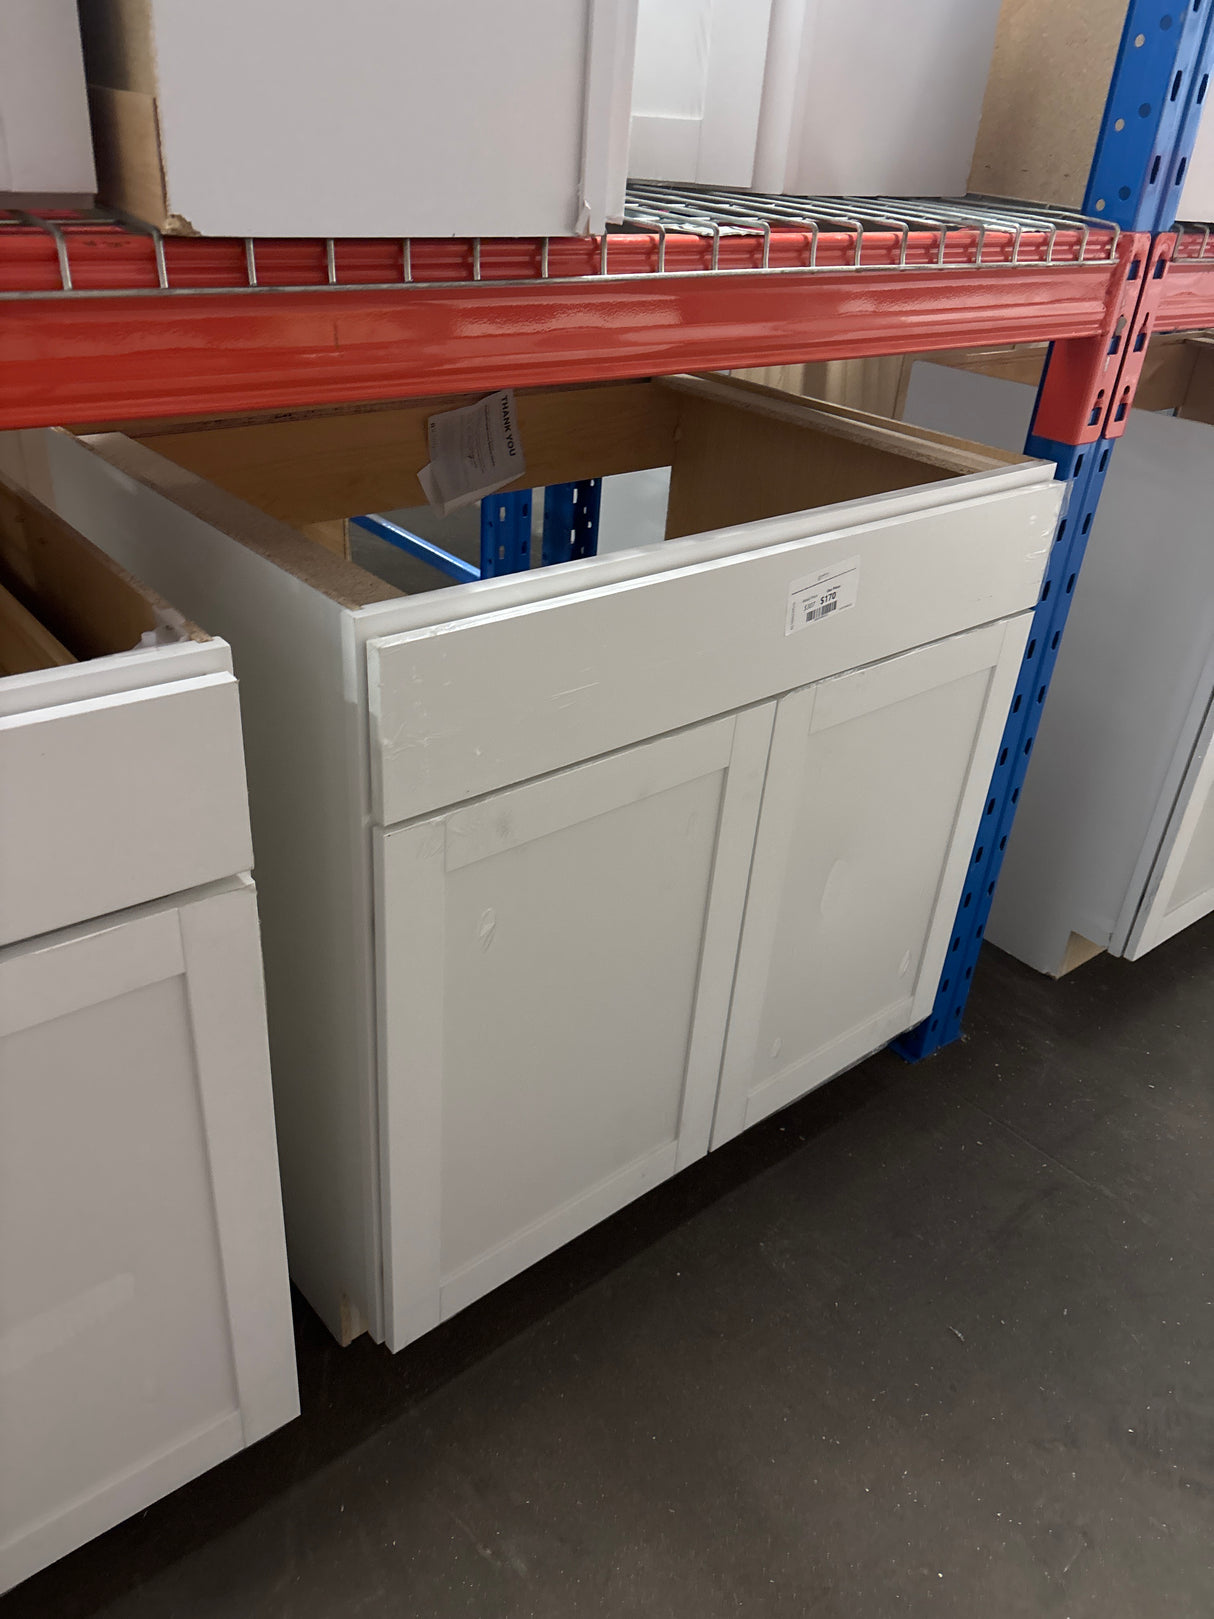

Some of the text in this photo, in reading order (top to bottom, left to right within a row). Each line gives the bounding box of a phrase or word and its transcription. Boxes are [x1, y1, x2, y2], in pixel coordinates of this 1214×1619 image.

[501, 395, 516, 457] THANK YOU
[820, 591, 837, 605] $170
